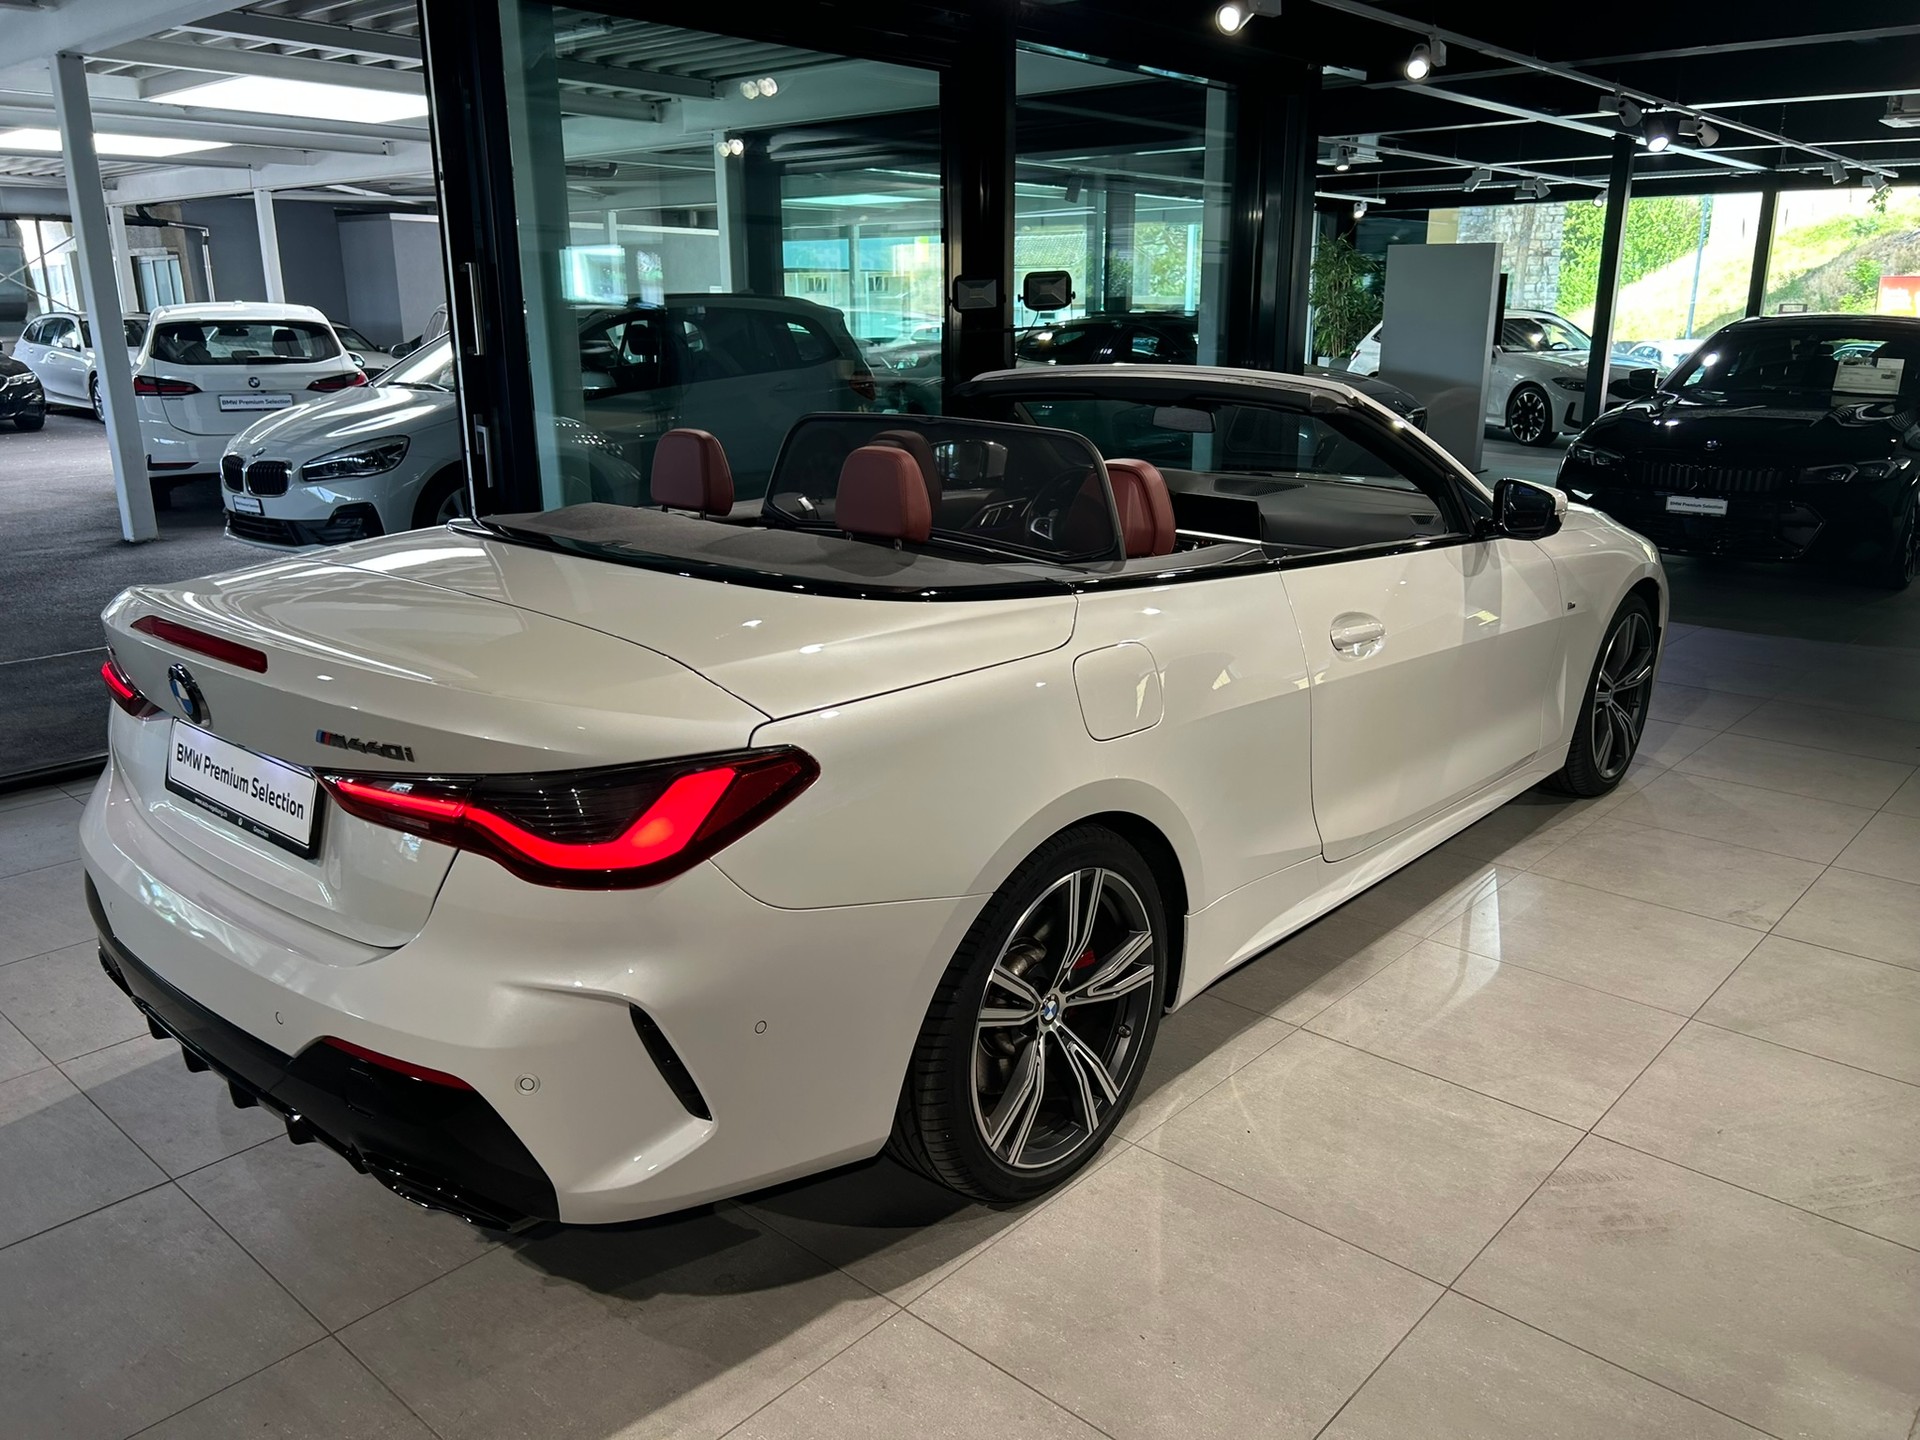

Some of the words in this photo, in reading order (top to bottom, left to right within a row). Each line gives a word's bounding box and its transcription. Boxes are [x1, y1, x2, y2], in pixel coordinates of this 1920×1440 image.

[176, 742, 203, 771] BMW
[203, 755, 249, 794] Premium
[250, 777, 304, 820] Selection
